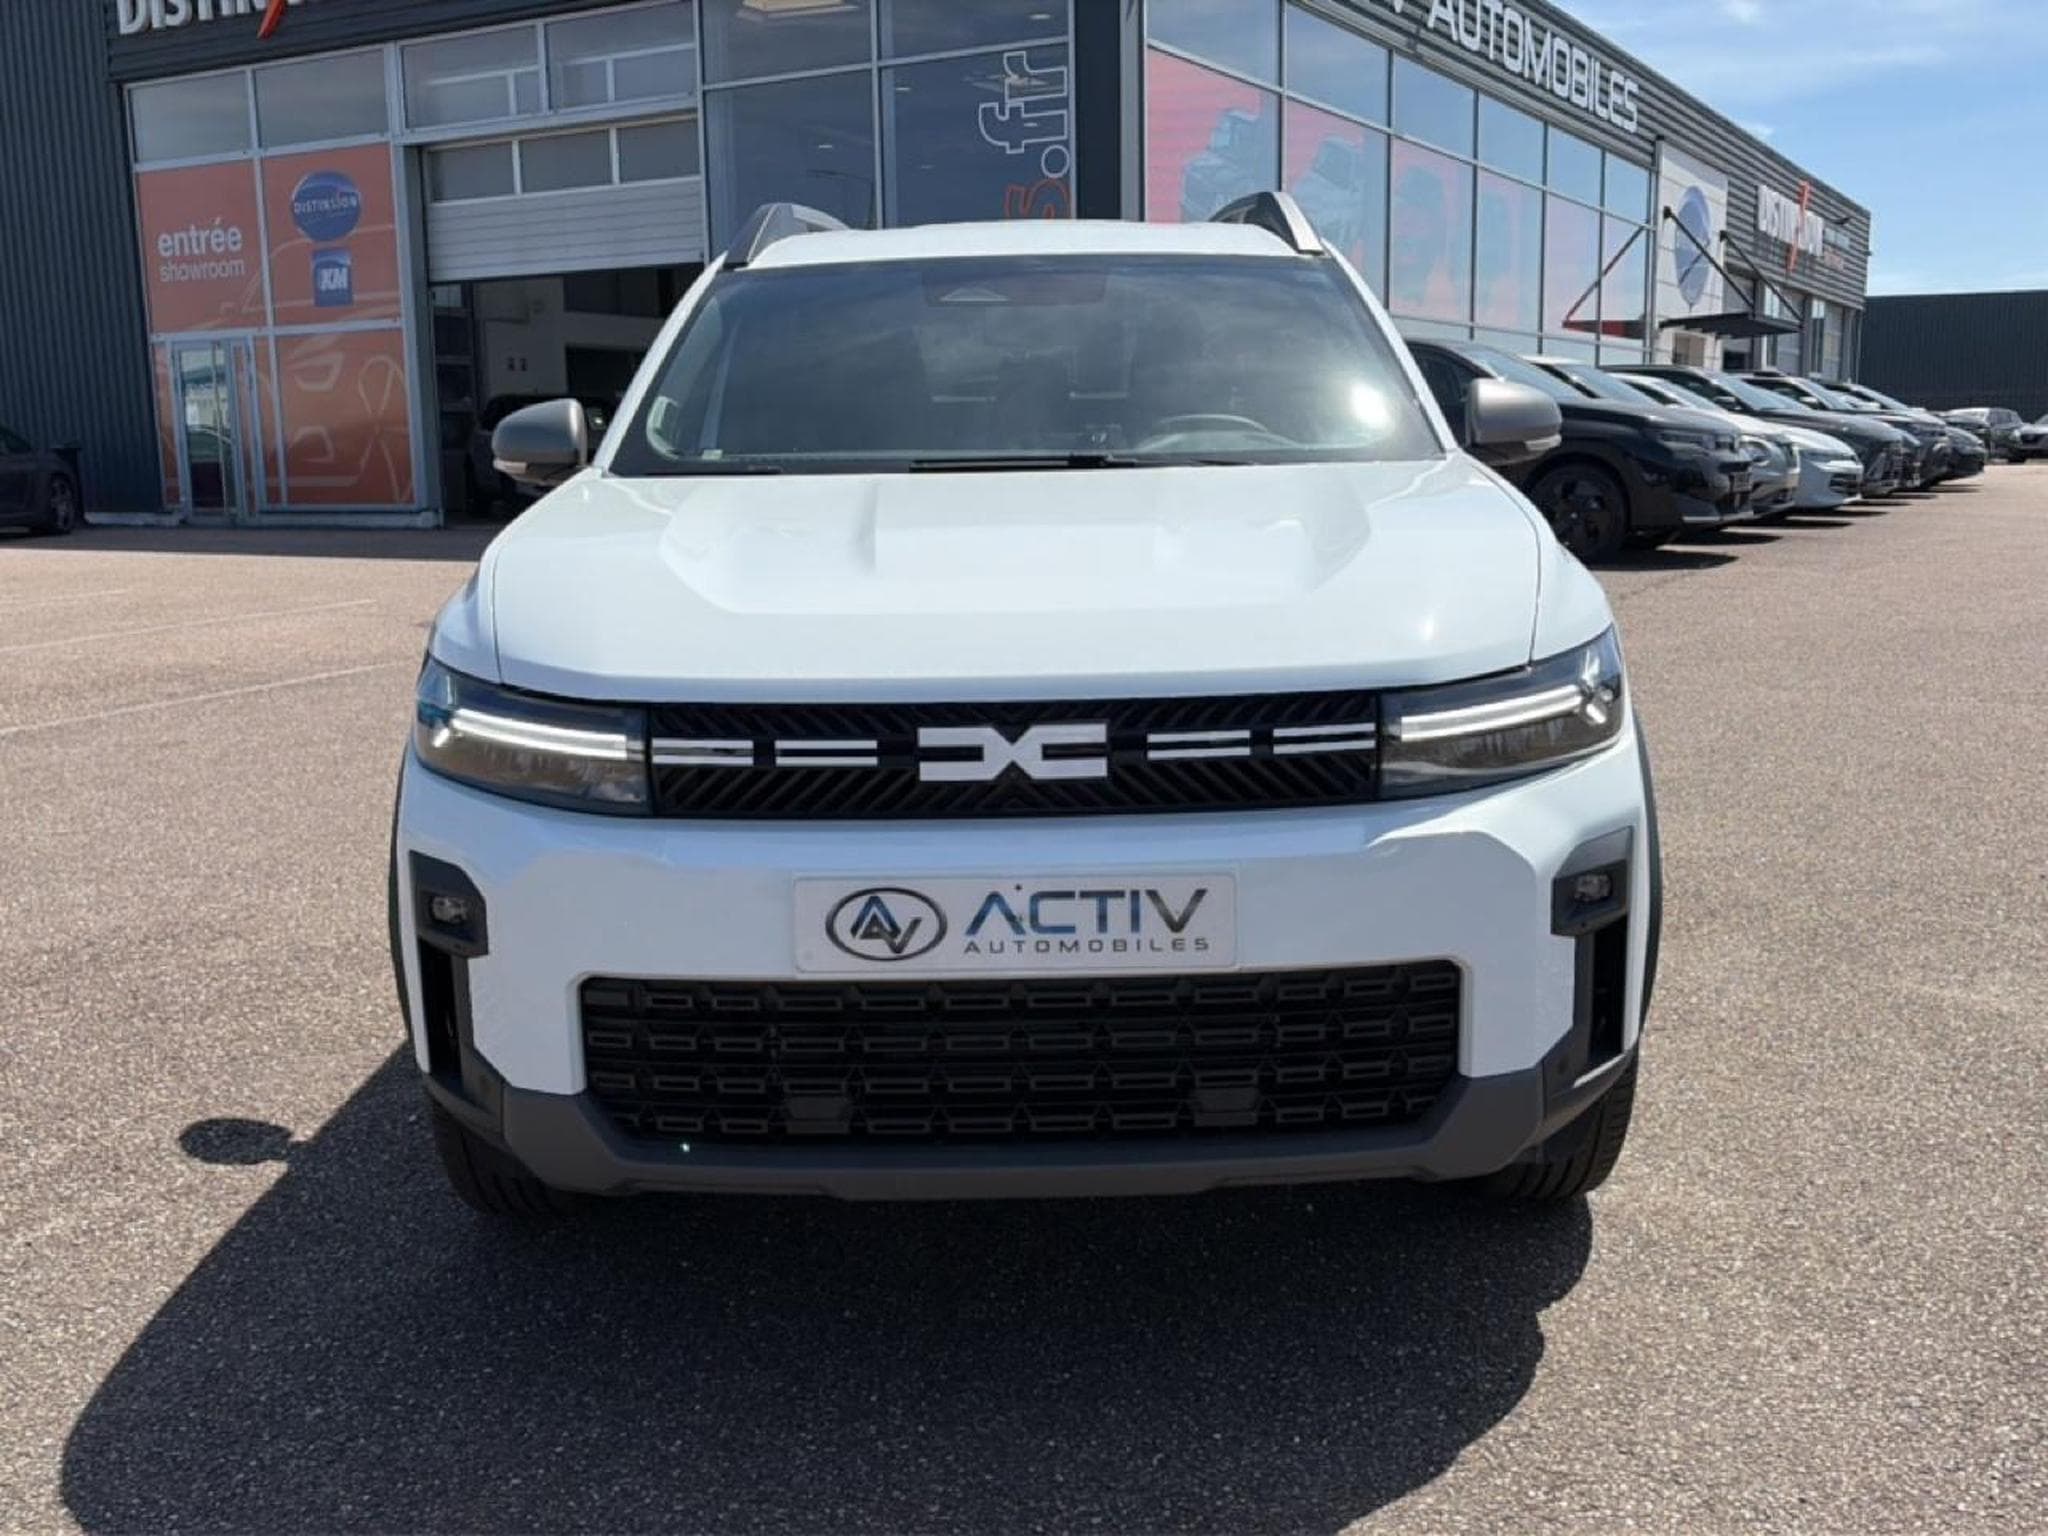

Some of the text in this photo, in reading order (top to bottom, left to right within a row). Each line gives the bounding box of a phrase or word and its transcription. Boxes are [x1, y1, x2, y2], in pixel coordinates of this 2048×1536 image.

[1427, 0, 1640, 134] AUTOMOBILES
[157, 217, 243, 257] entrée
[159, 258, 245, 282] showroom
[965, 888, 1208, 936] ACTIV
[964, 937, 1209, 954] AUTOMOBILES
